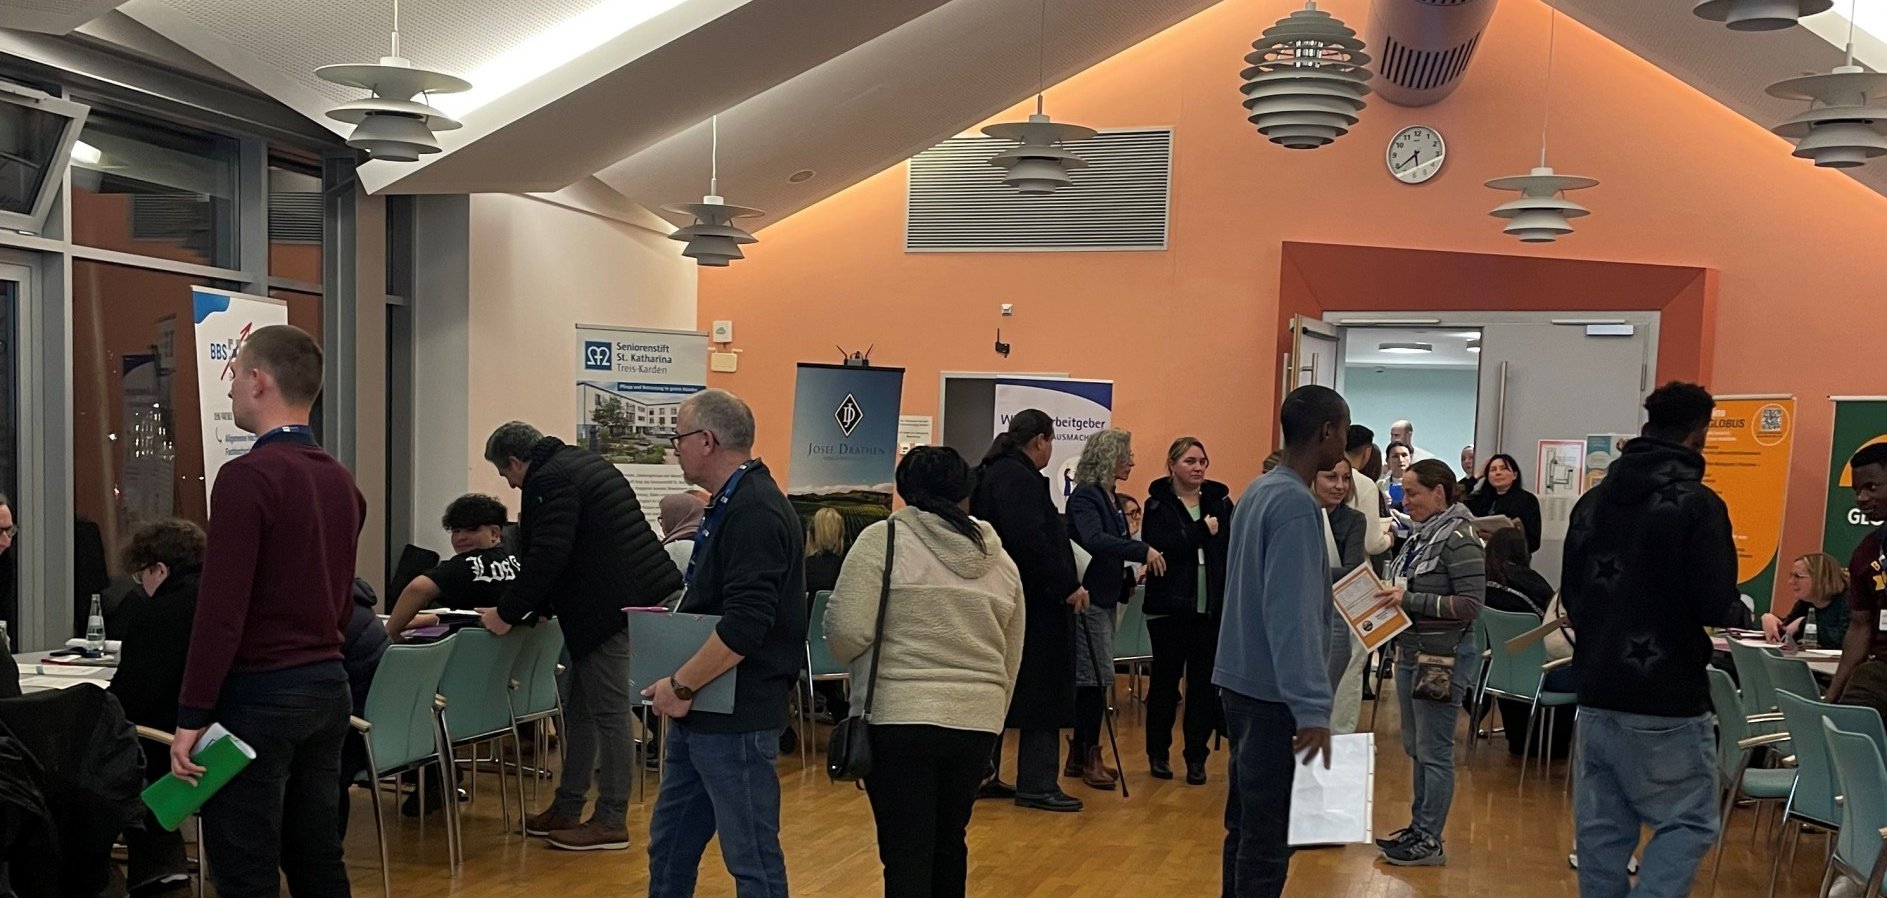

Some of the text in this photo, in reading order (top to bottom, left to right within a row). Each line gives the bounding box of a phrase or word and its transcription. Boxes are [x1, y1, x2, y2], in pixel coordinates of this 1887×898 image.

[210, 343, 227, 361] BBS
[616, 342, 670, 353] Seniorenstift
[616, 353, 673, 364] St. Katharina
[617, 363, 668, 375] Treis-Karden
